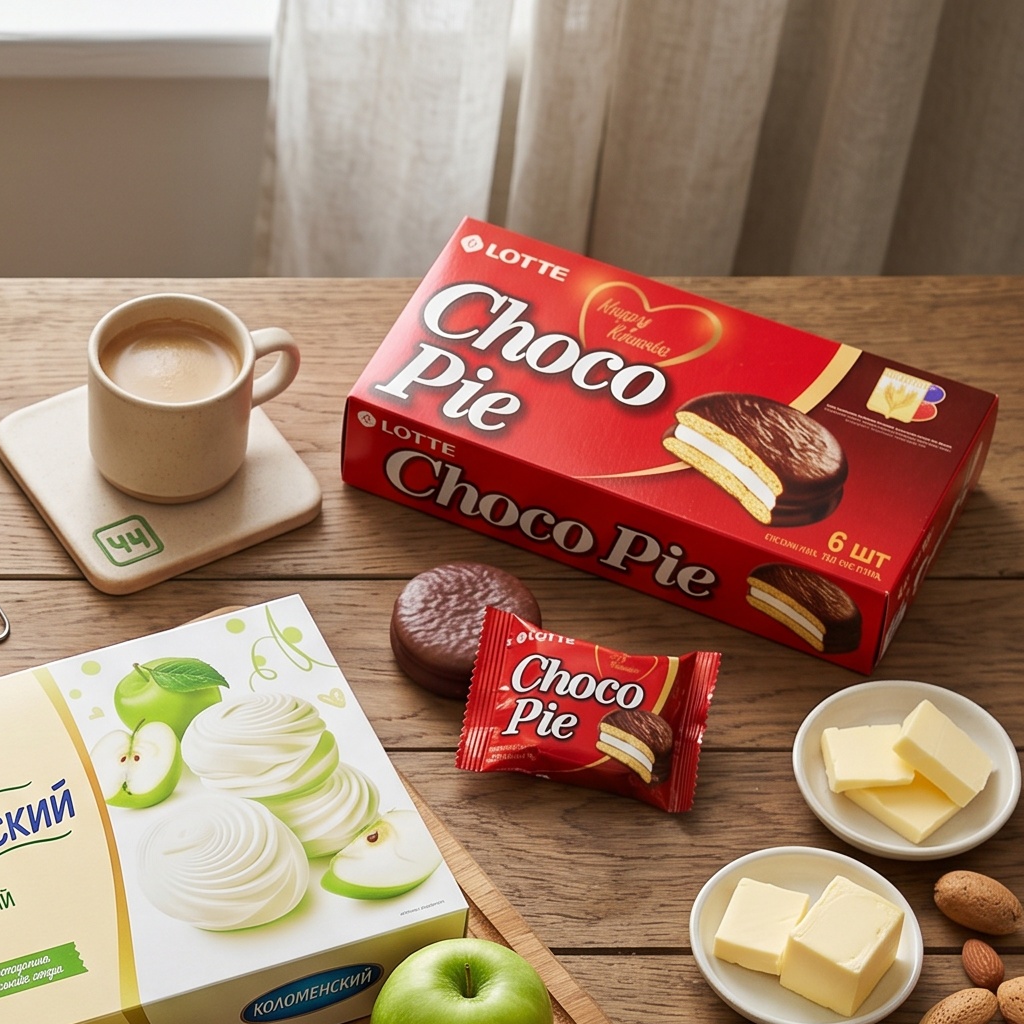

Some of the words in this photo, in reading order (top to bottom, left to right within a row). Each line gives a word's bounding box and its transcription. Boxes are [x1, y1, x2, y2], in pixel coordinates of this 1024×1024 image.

[485, 243, 570, 283] LOTTE
[422, 282, 668, 407] Choco
[374, 343, 522, 432] Pie
[381, 420, 456, 459] LOTTE
[383, 447, 595, 556] Choco
[600, 523, 718, 601] Pie
[827, 531, 848, 553] 6
[510, 653, 645, 710] Choco
[501, 697, 580, 740] Pie
[252, 967, 373, 1018] КОЛОМЕНСКИЙ
